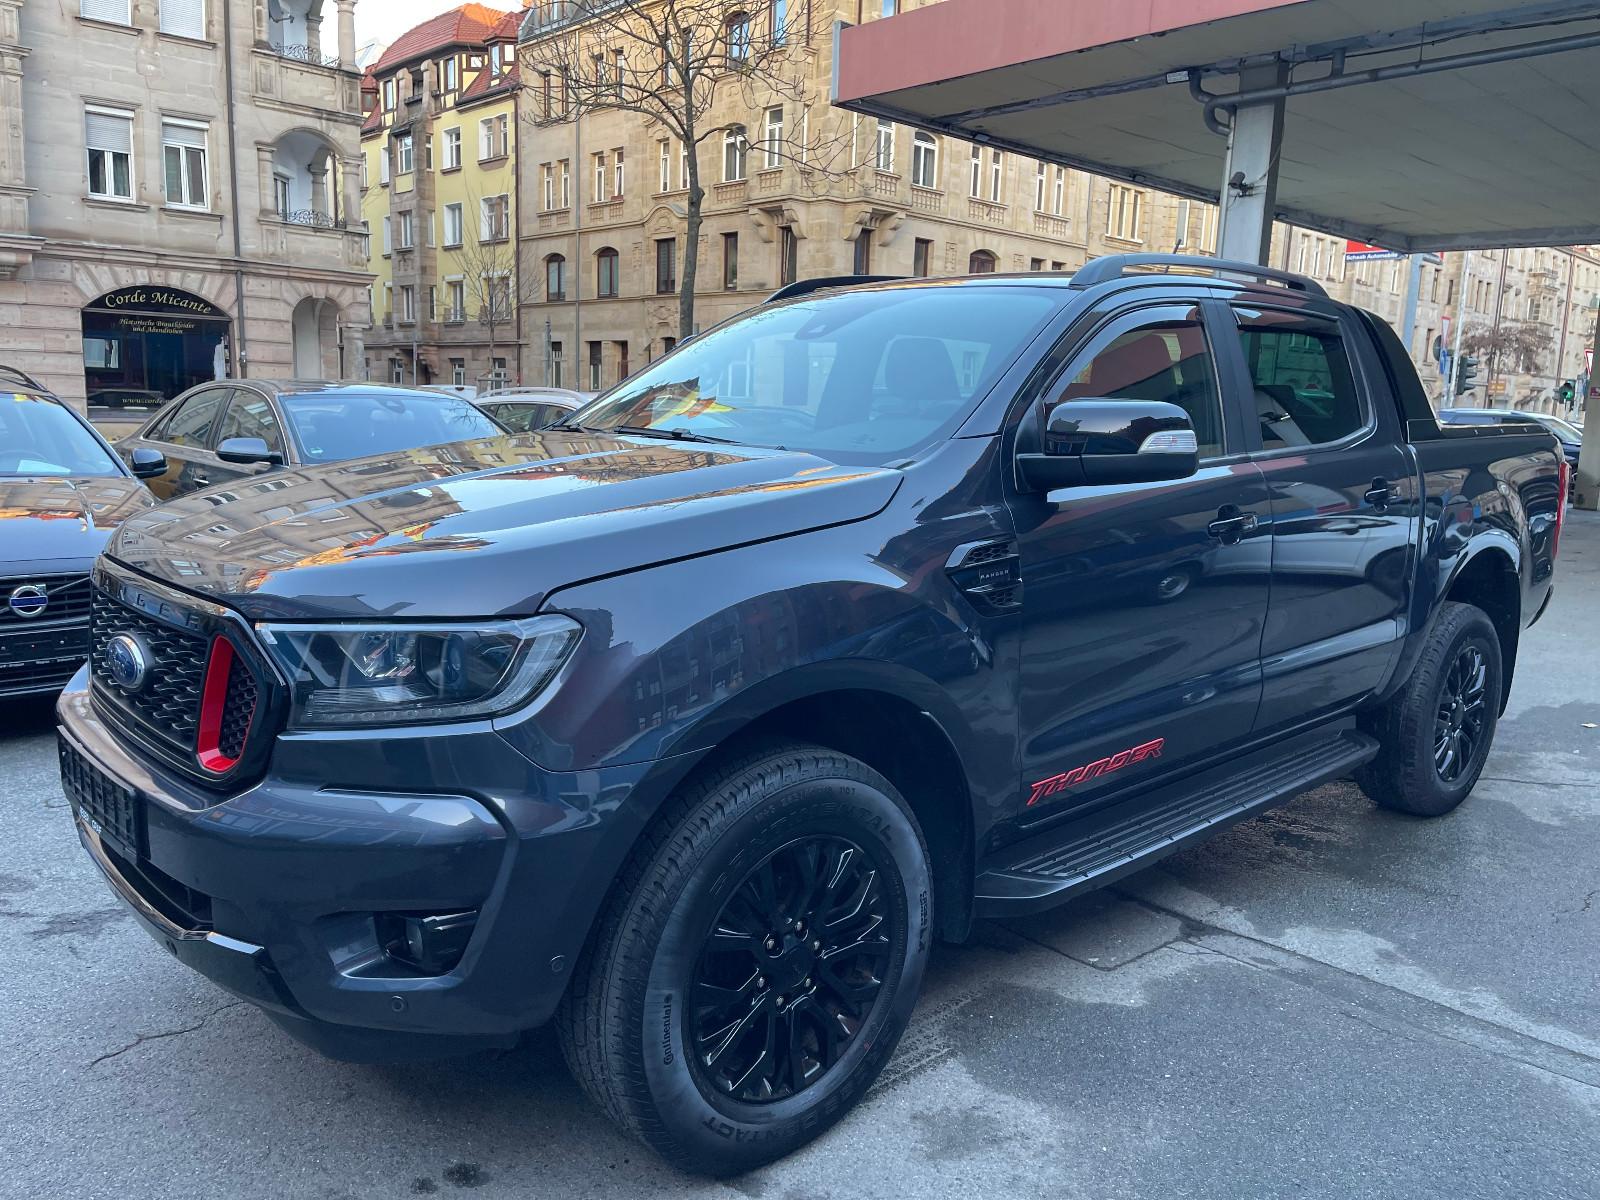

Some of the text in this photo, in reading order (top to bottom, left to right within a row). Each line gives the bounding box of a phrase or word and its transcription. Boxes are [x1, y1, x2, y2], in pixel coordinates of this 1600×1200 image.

[106, 290, 212, 314] Corde Micante
[1026, 737, 1165, 807] THUNDER
[662, 1003, 674, 1066] Continental
